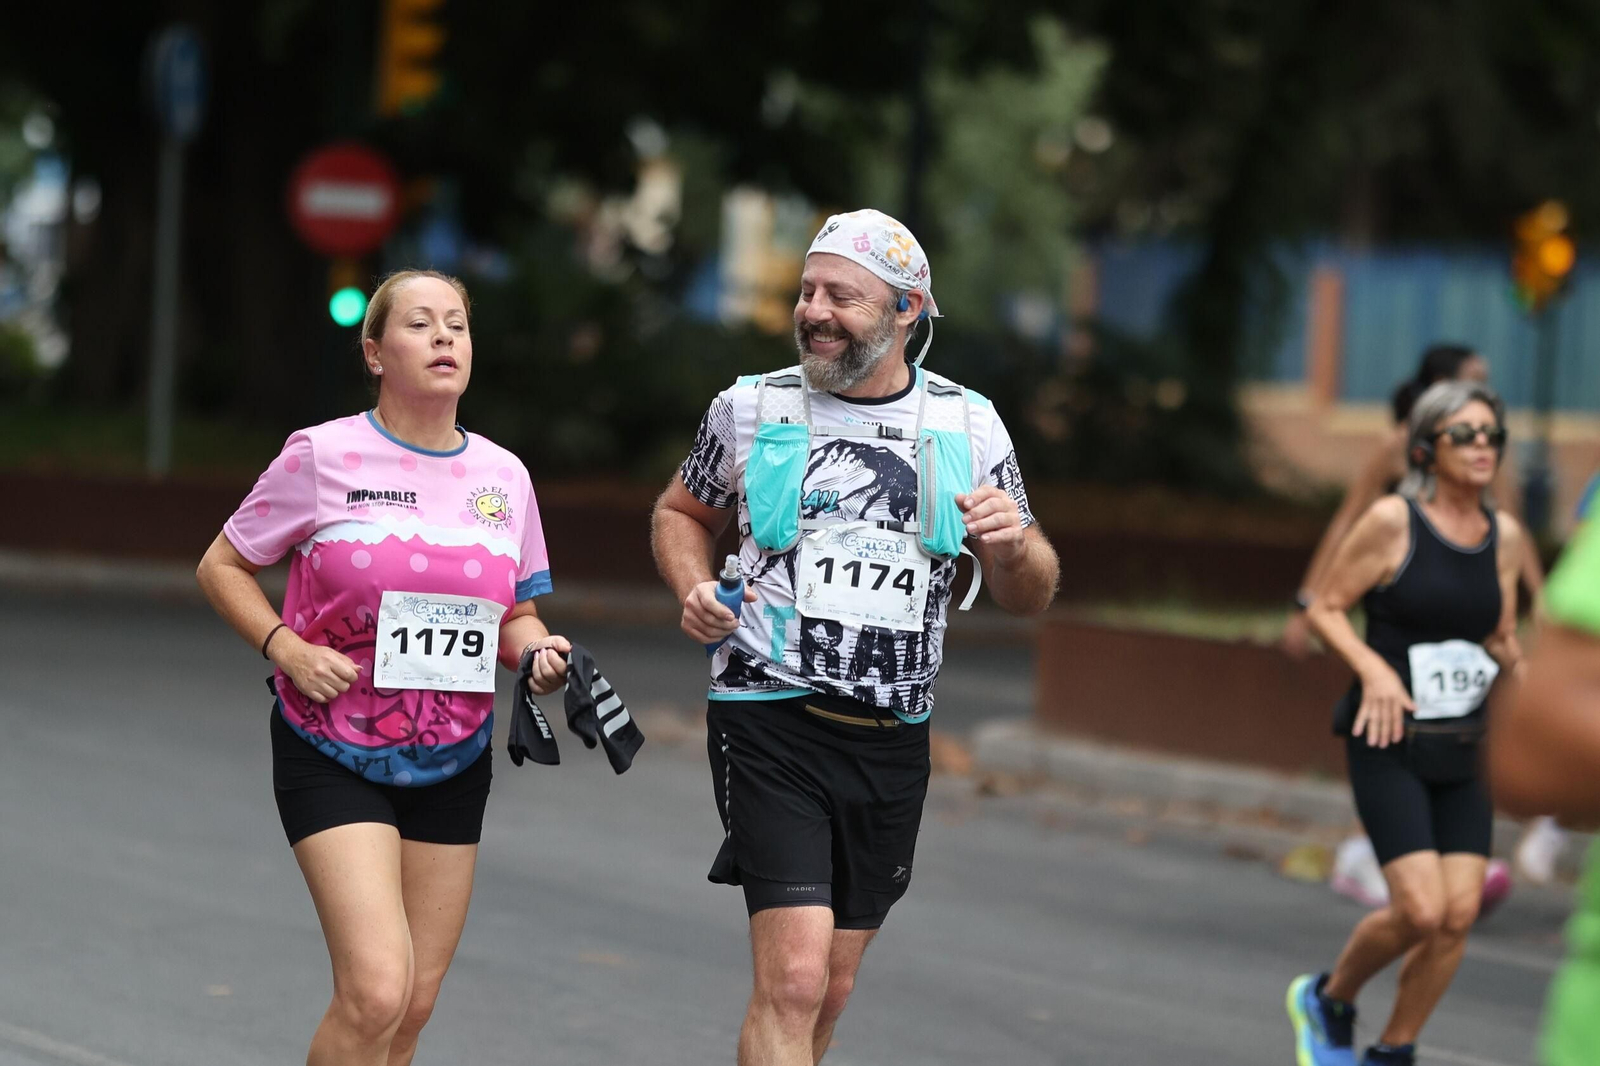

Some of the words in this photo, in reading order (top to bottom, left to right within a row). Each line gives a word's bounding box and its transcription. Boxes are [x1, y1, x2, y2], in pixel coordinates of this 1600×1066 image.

[346, 489, 417, 504] IMPARABLES
[476, 486, 489, 494] LA
[466, 498, 492, 528] LENGUA
[502, 506, 514, 529] SACA
[493, 523, 504, 531] LA
[842, 532, 897, 550] Carrera
[856, 547, 899, 562] Prensa
[815, 557, 915, 596] 1174
[413, 600, 467, 615] Carrera
[426, 613, 468, 625] Prensa
[322, 628, 345, 649] A
[391, 627, 485, 657] 1179
[353, 755, 394, 778] LA
